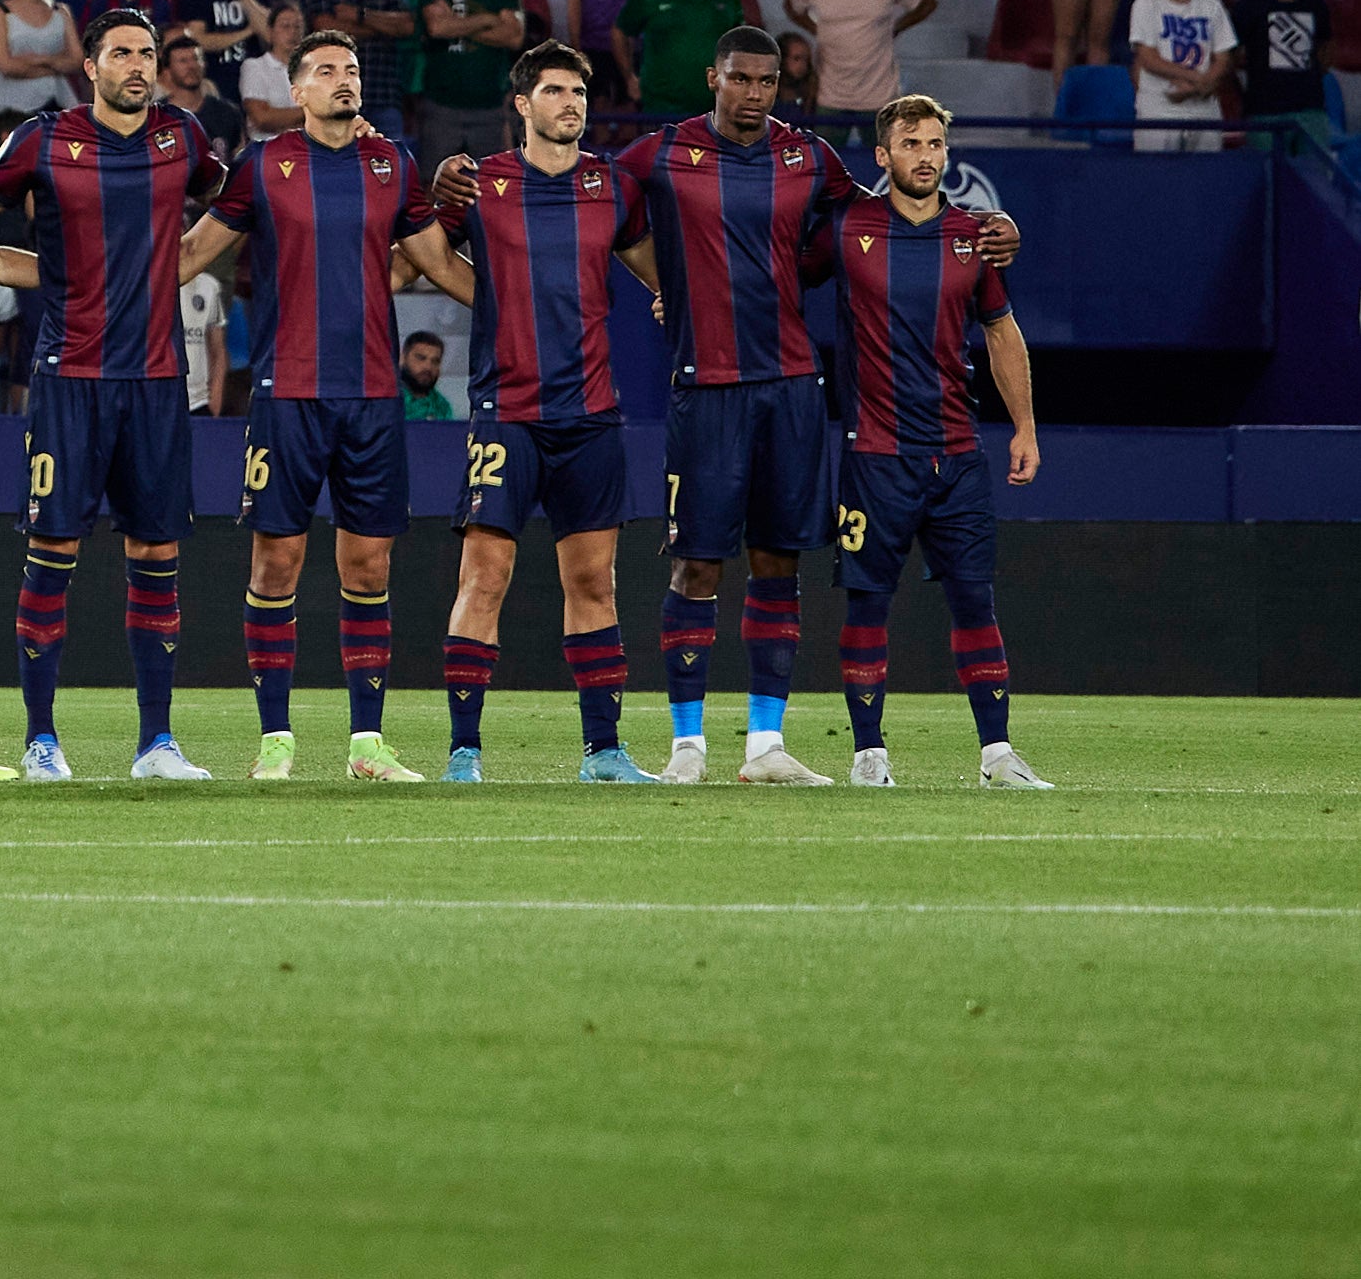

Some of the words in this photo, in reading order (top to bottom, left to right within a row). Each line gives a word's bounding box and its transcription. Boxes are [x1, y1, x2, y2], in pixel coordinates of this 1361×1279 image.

[212, 0, 244, 27] NO
[1161, 14, 1209, 40] JUST
[244, 445, 269, 491] 16
[468, 442, 506, 487] 22
